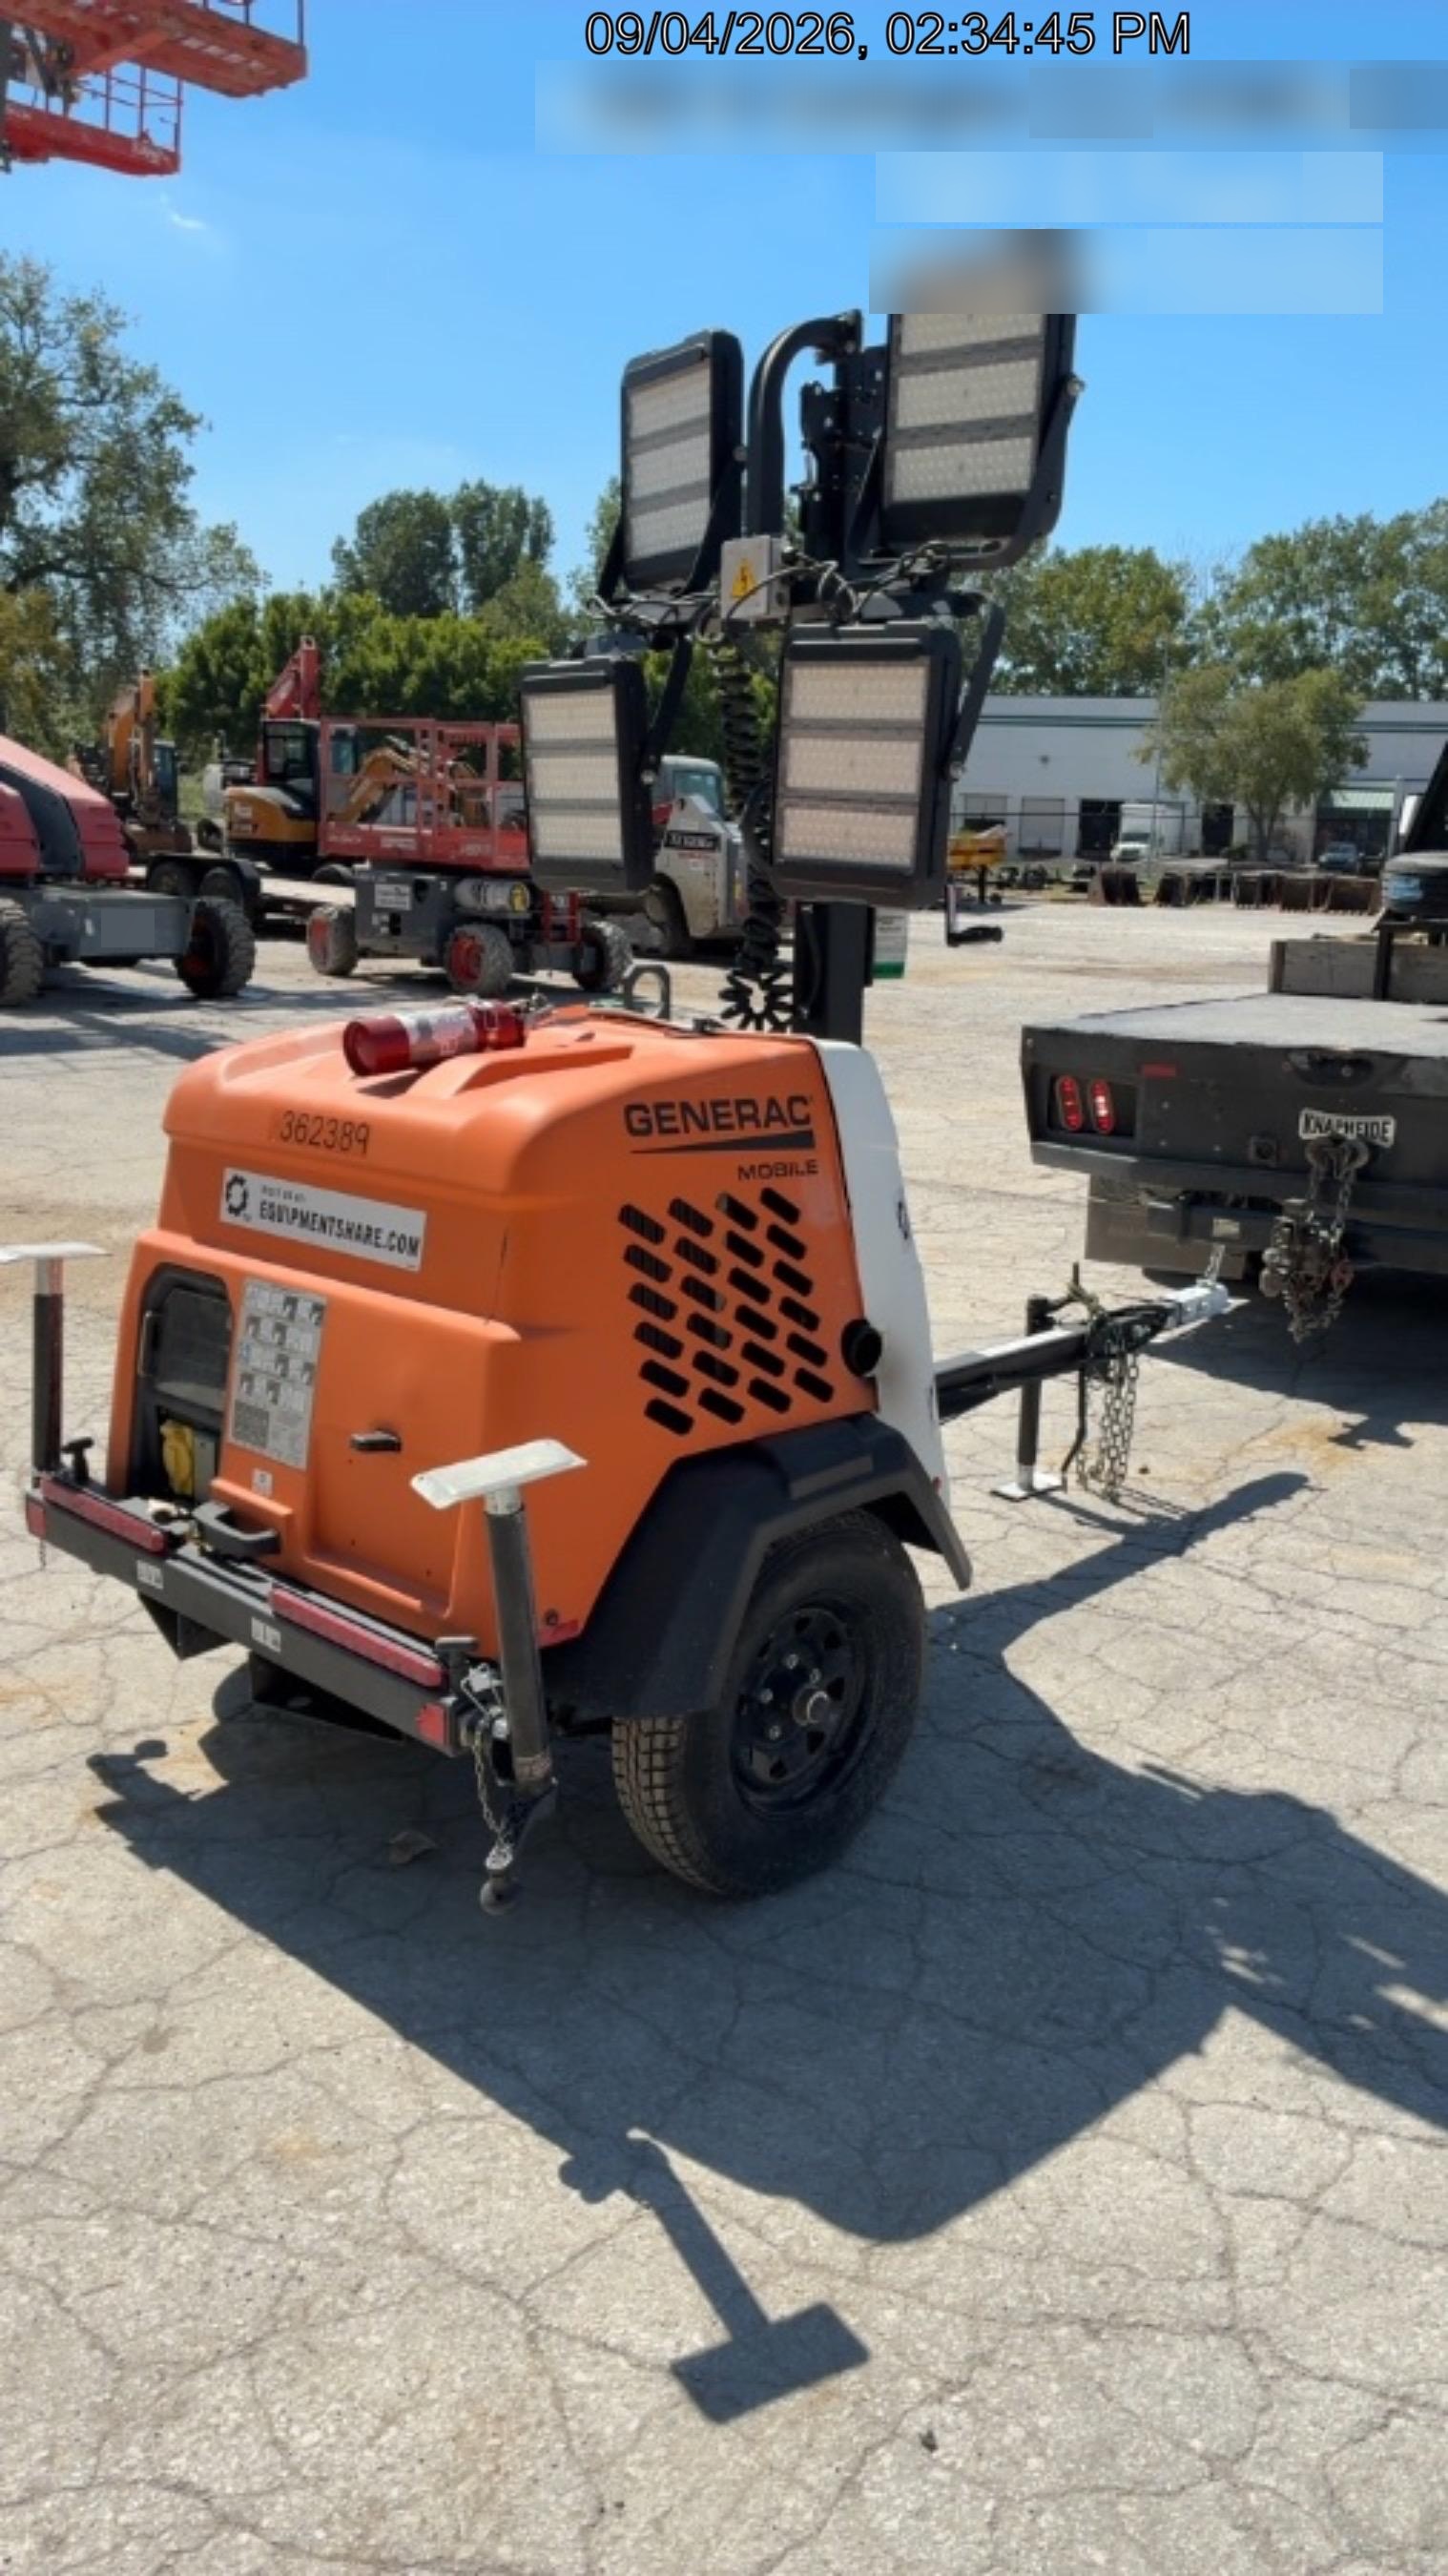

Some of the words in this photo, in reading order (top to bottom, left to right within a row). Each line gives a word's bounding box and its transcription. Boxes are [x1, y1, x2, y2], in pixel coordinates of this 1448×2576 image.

[279, 1110, 371, 1154] 362389
[623, 1095, 812, 1137] GENERAC
[737, 1158, 818, 1181] MOBILE
[259, 1199, 420, 1257] EQUIPMENTSHARE.COM
